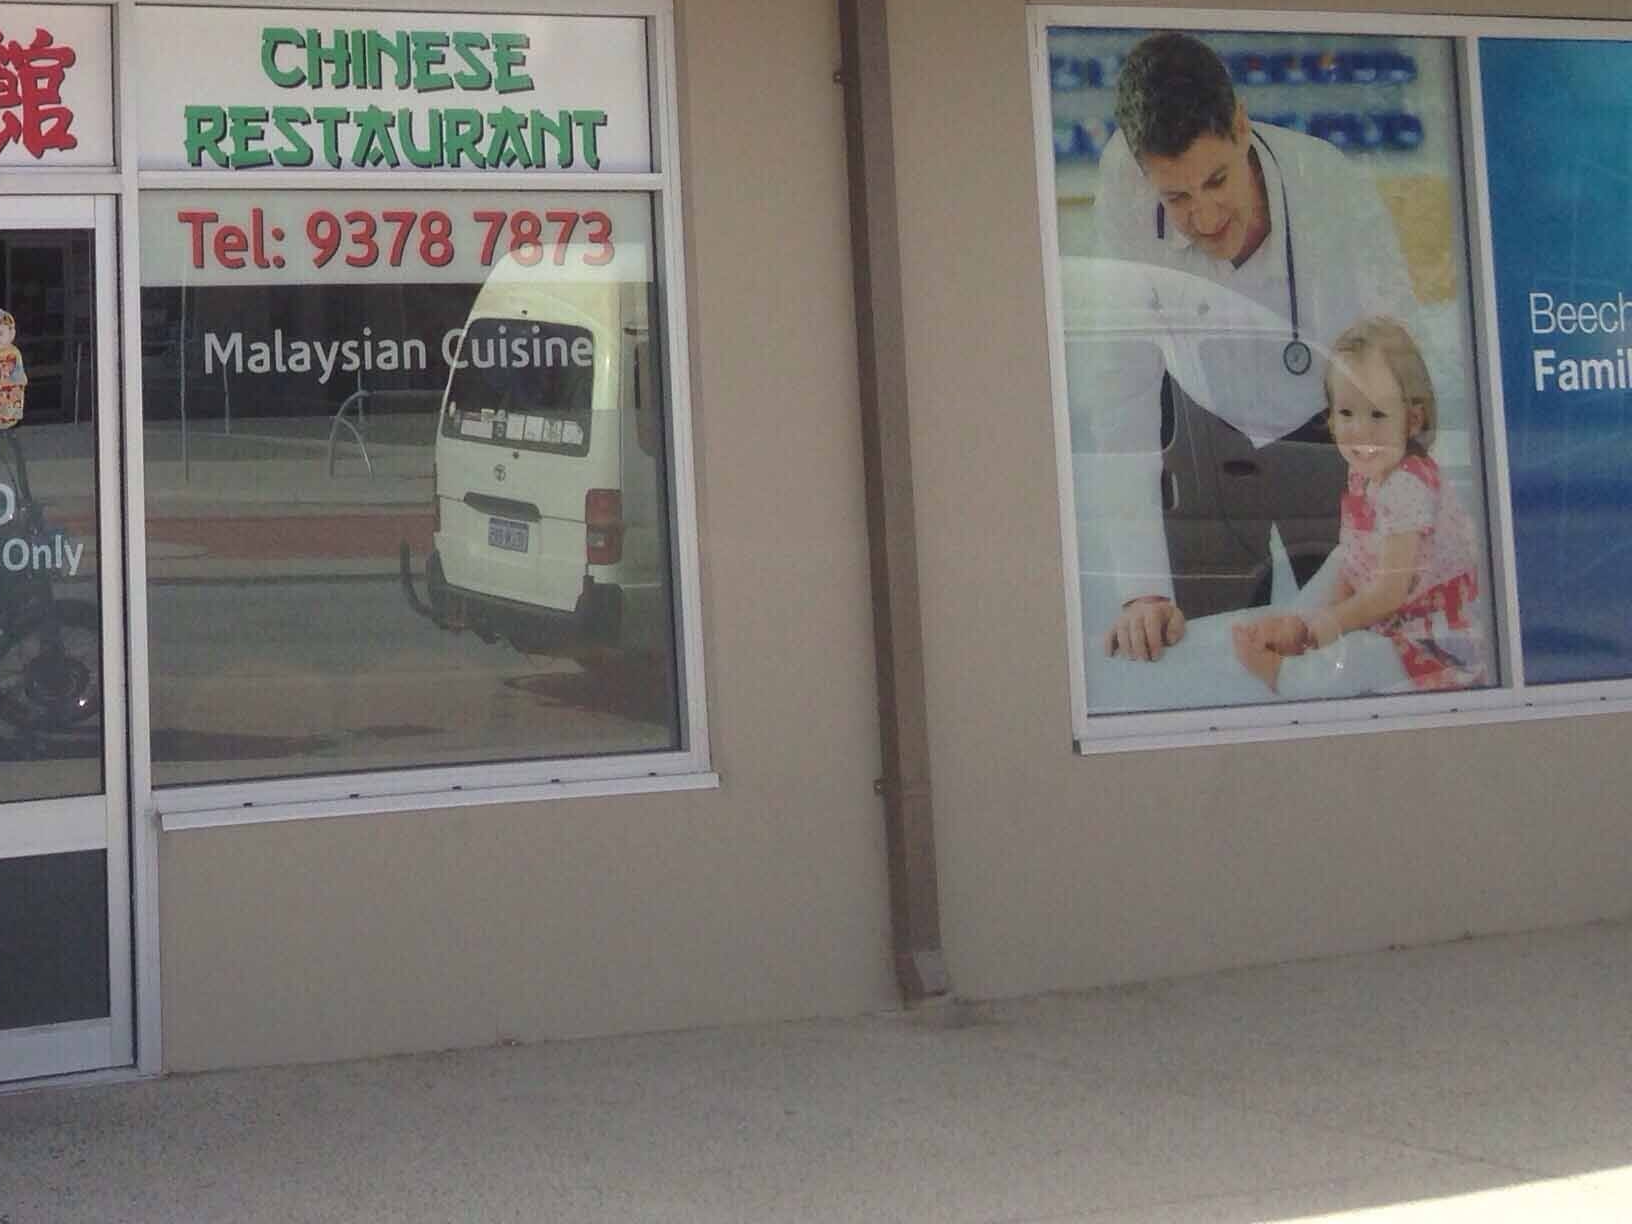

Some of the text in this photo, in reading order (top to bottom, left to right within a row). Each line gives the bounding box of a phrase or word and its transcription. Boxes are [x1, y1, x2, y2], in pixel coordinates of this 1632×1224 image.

[261, 27, 535, 93] CHINESE
[184, 105, 608, 170] RESTAURANT
[177, 208, 616, 269] Tel: 9378 7873
[1529, 291, 1632, 334] Beech
[204, 325, 594, 385] Malaysian Cuisine
[1, 534, 85, 577] Only
